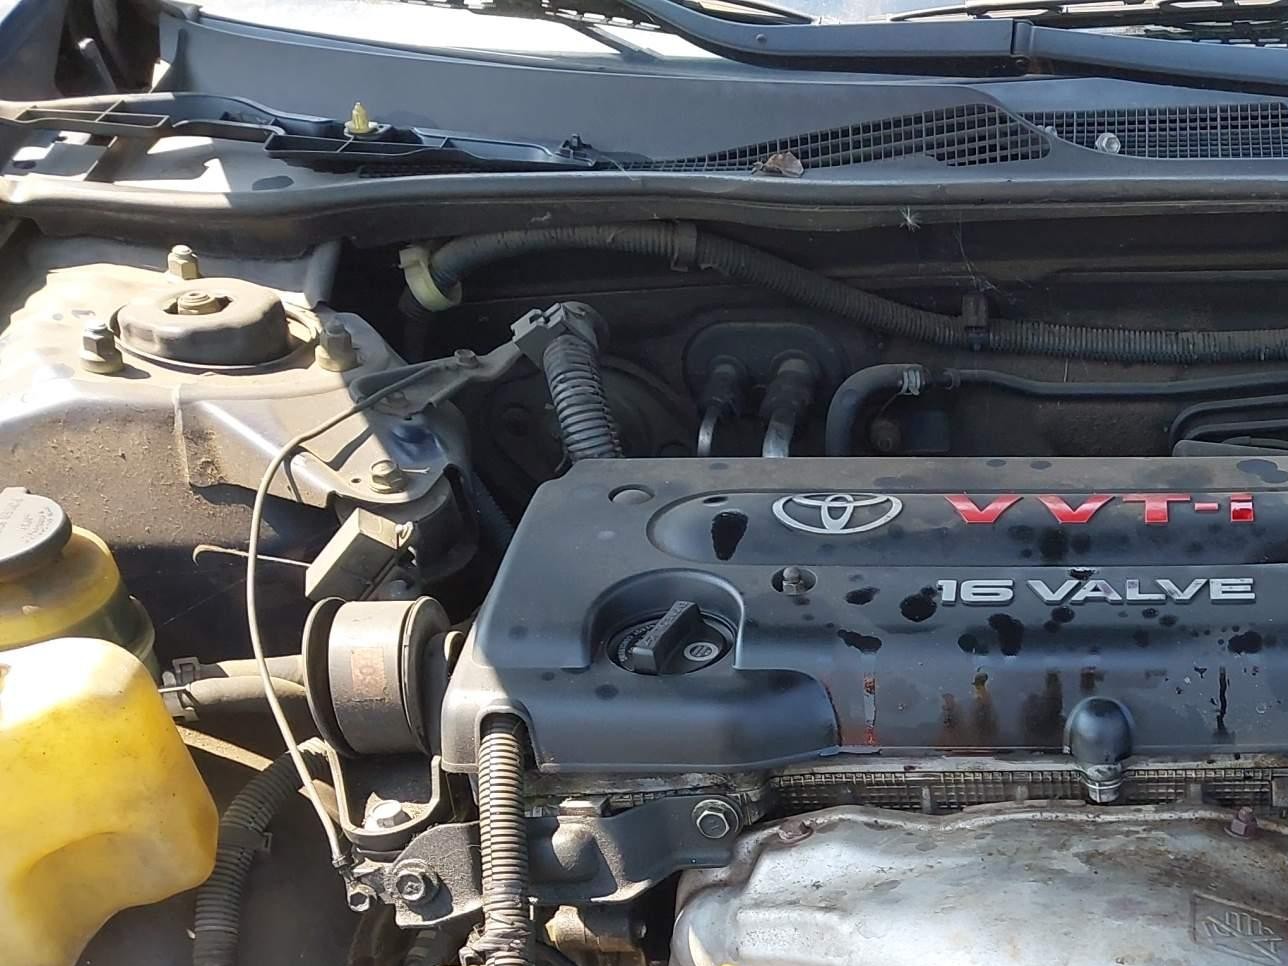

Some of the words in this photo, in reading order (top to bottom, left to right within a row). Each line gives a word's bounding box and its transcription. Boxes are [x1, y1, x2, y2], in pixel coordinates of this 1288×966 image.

[943, 493, 1254, 525] VVT-i
[936, 578, 1015, 603] 16
[1027, 577, 1256, 602] VALVE
